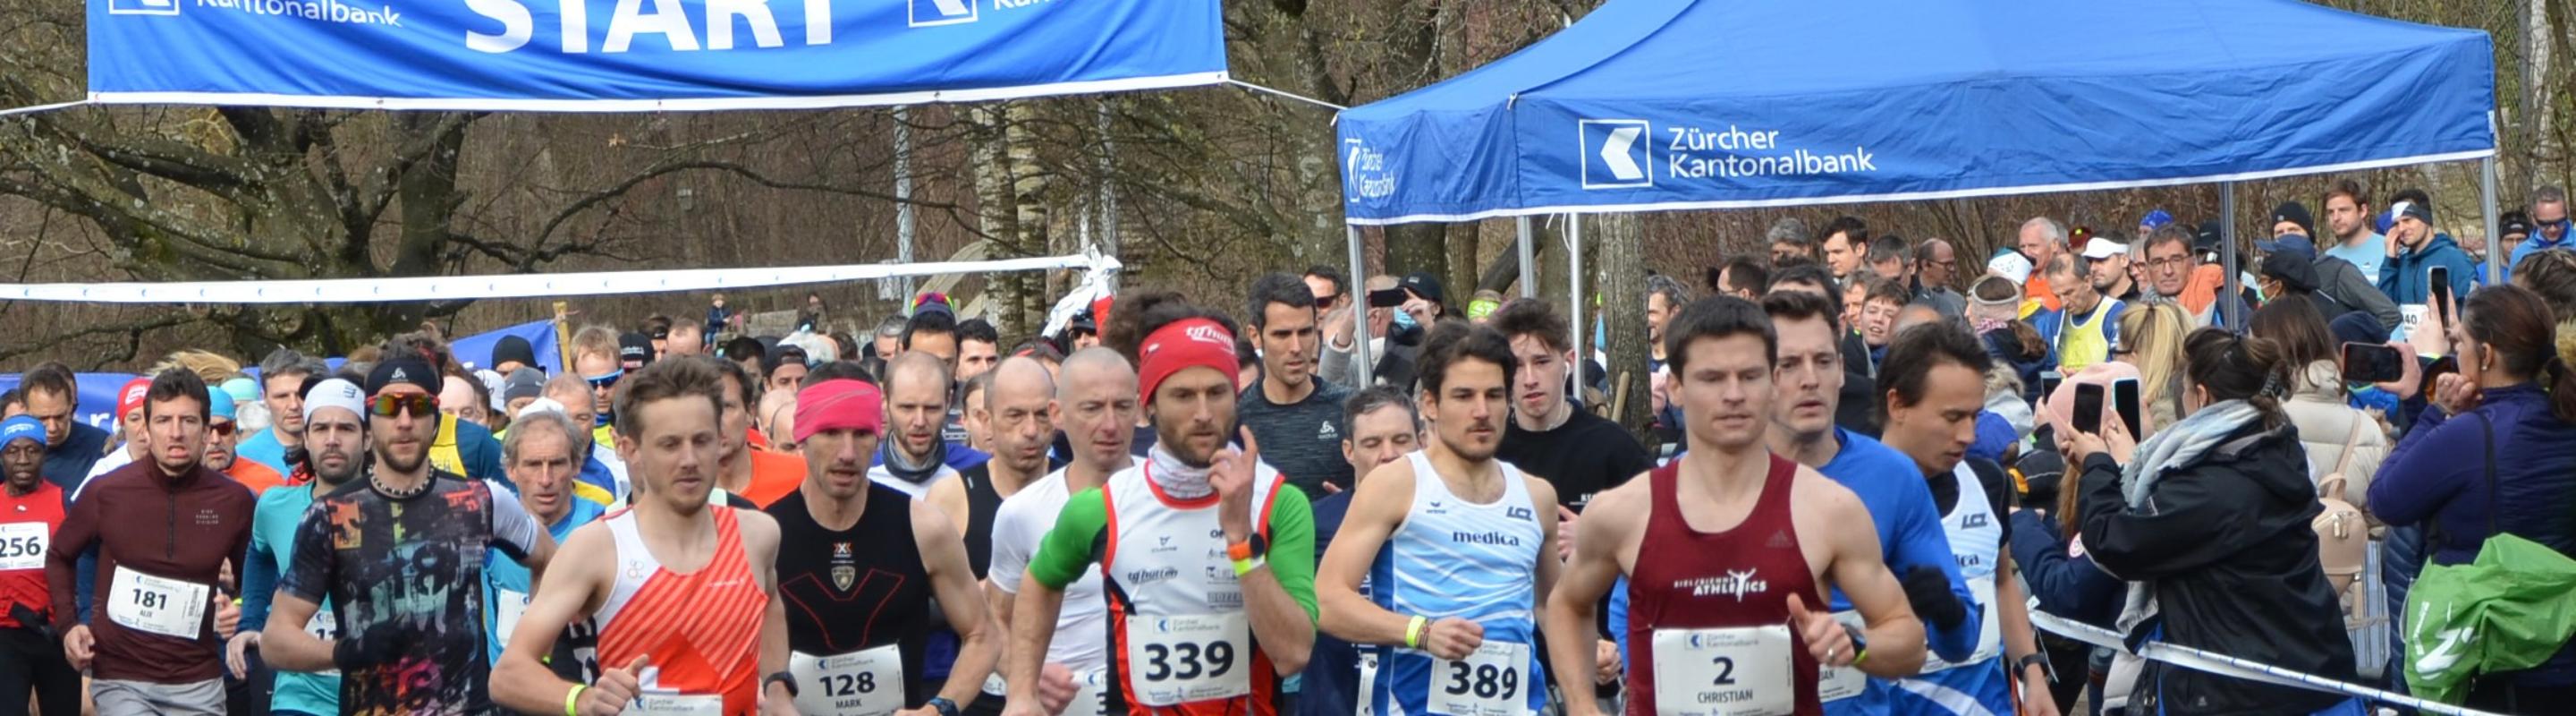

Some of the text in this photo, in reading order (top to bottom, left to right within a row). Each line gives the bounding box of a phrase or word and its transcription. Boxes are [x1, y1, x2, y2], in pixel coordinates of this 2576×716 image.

[1667, 124, 1779, 151] Zürcher
[1668, 146, 1877, 179] Kantonalbank
[0, 535, 41, 558] 256
[1453, 531, 1520, 546] medica
[132, 587, 167, 610] 181
[1144, 639, 1234, 682] 339
[1712, 655, 1735, 686] 2
[818, 671, 876, 697] 128
[1445, 660, 1518, 702] 389
[835, 699, 862, 710] MARK
[1697, 689, 1753, 703] CHRISTIAN
